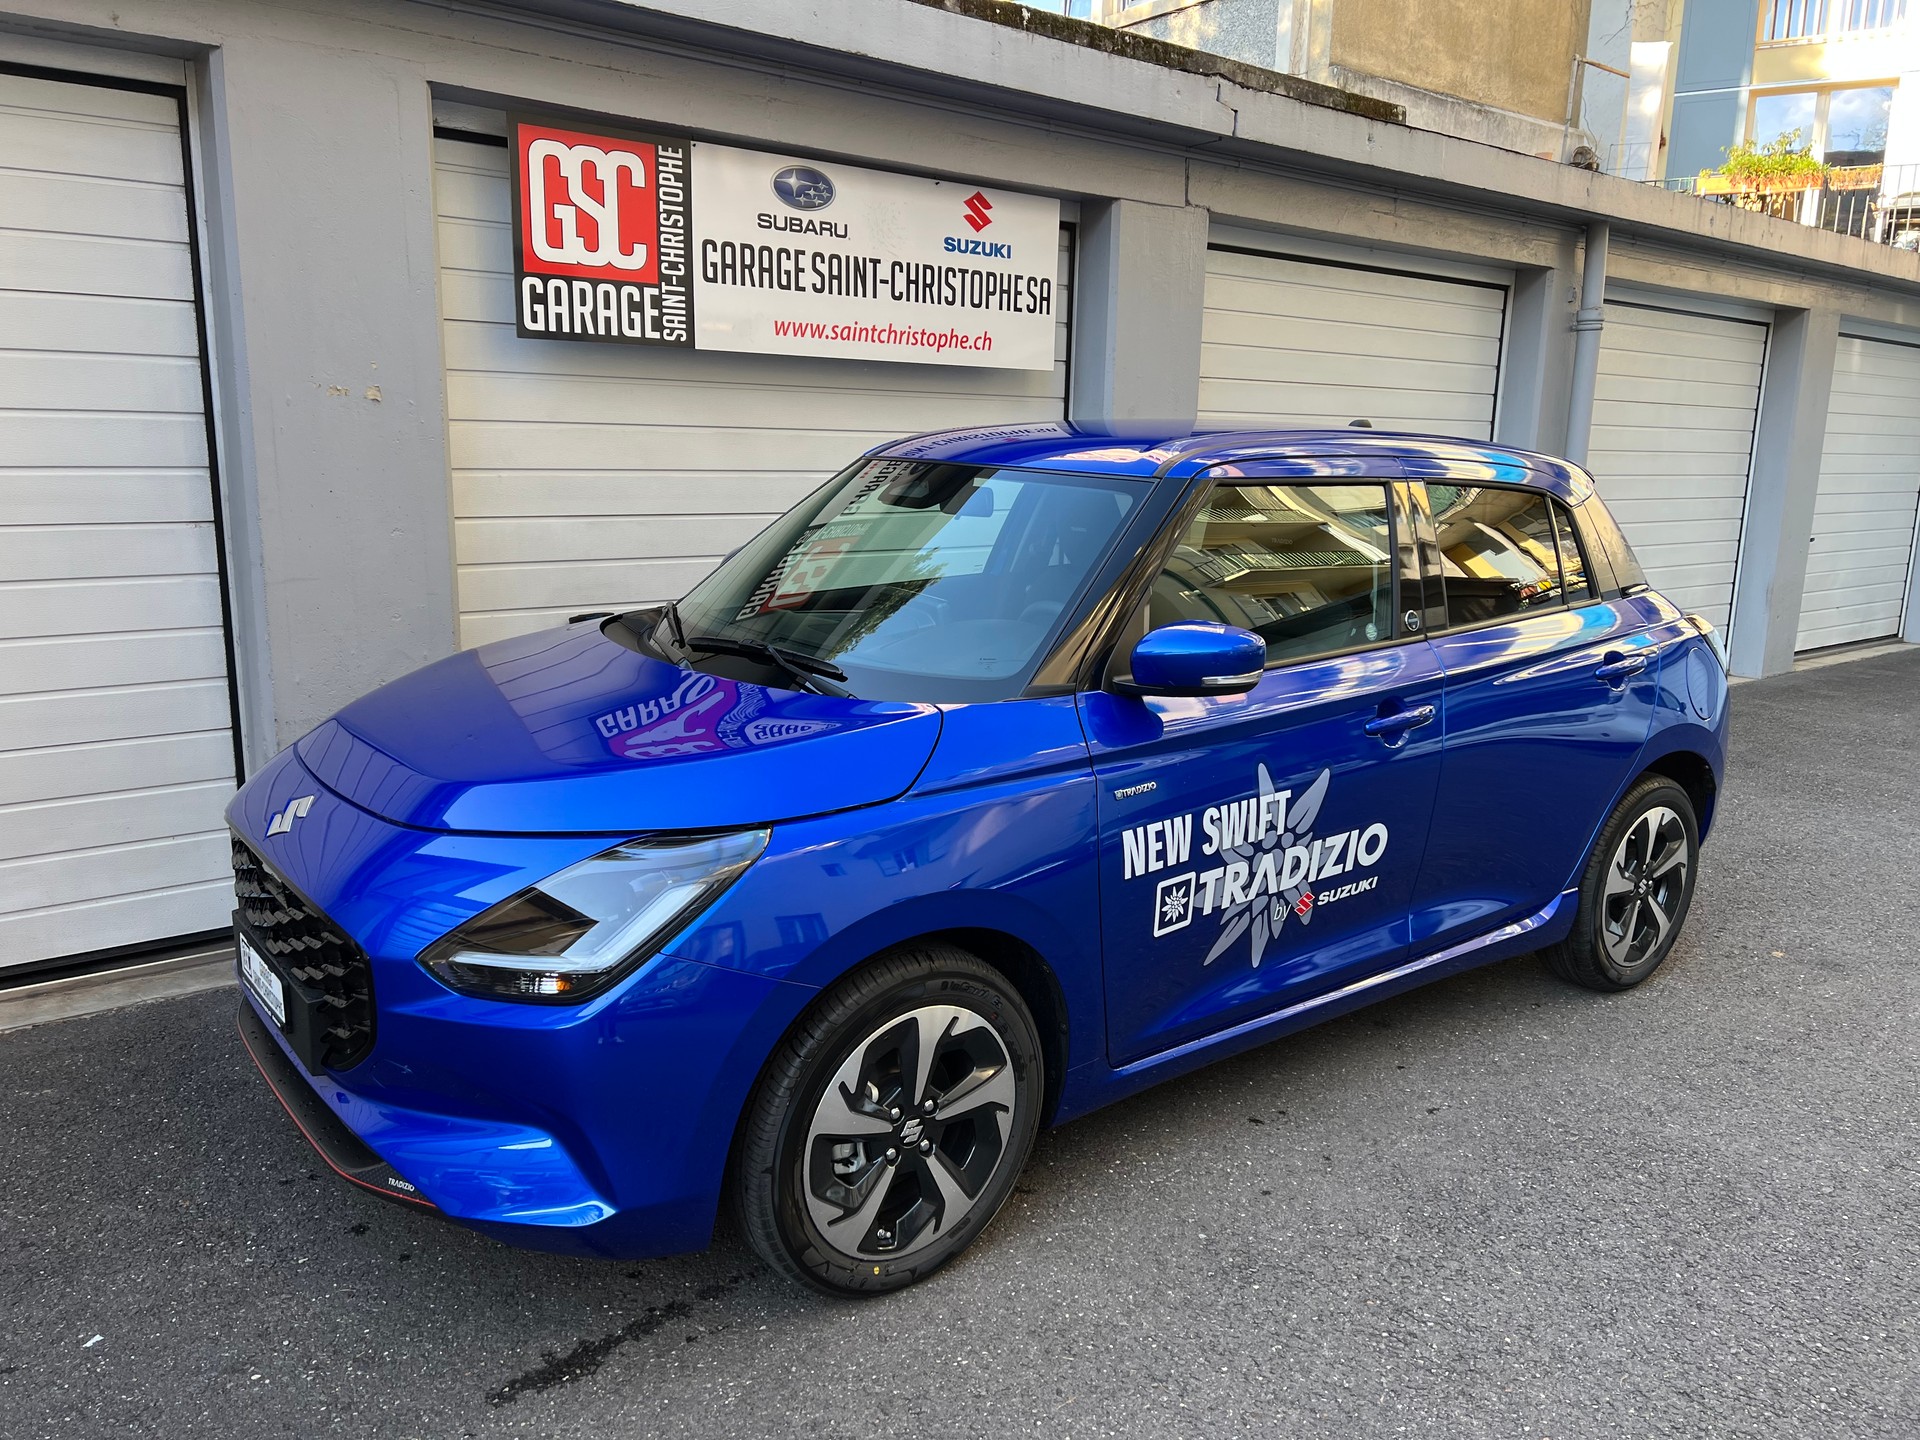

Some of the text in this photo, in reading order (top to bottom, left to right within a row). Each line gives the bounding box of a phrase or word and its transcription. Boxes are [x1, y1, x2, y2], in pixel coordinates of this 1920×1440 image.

[528, 138, 648, 271] GSC
[757, 212, 849, 239] SUBARU
[658, 145, 687, 342] SAINT-CHRISTOPHE
[943, 236, 1012, 259] SUZUKI
[521, 276, 661, 339] GARAGE
[702, 238, 1052, 315] GARAGE SAINT-CHRISTOPHE SA
[774, 320, 992, 353] www.saintchristophe.ch
[1122, 781, 1157, 798] TRADIZIO
[1122, 789, 1292, 880] NEW SWIFT
[1199, 822, 1389, 916] TRADIZIO
[1273, 876, 1378, 921] by SUZUKI
